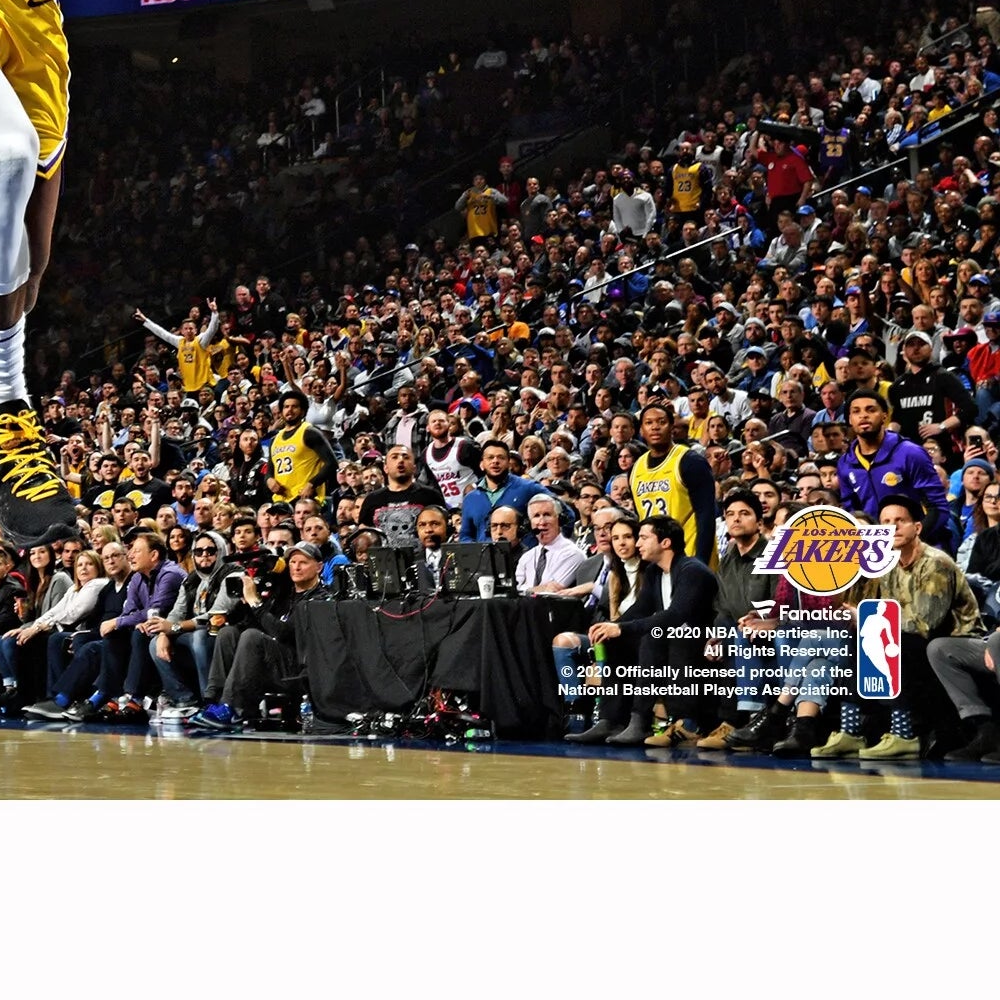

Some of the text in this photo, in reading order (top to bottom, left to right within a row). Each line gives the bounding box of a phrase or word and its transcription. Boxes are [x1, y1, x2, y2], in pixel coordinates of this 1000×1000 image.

[826, 142, 843, 157] 23
[678, 180, 692, 192] 23
[474, 204, 488, 215] 23
[923, 411, 933, 425] 6
[276, 456, 293, 474] 23
[441, 481, 461, 497] 25
[637, 480, 671, 497] LAKERS
[641, 498, 667, 518] 23
